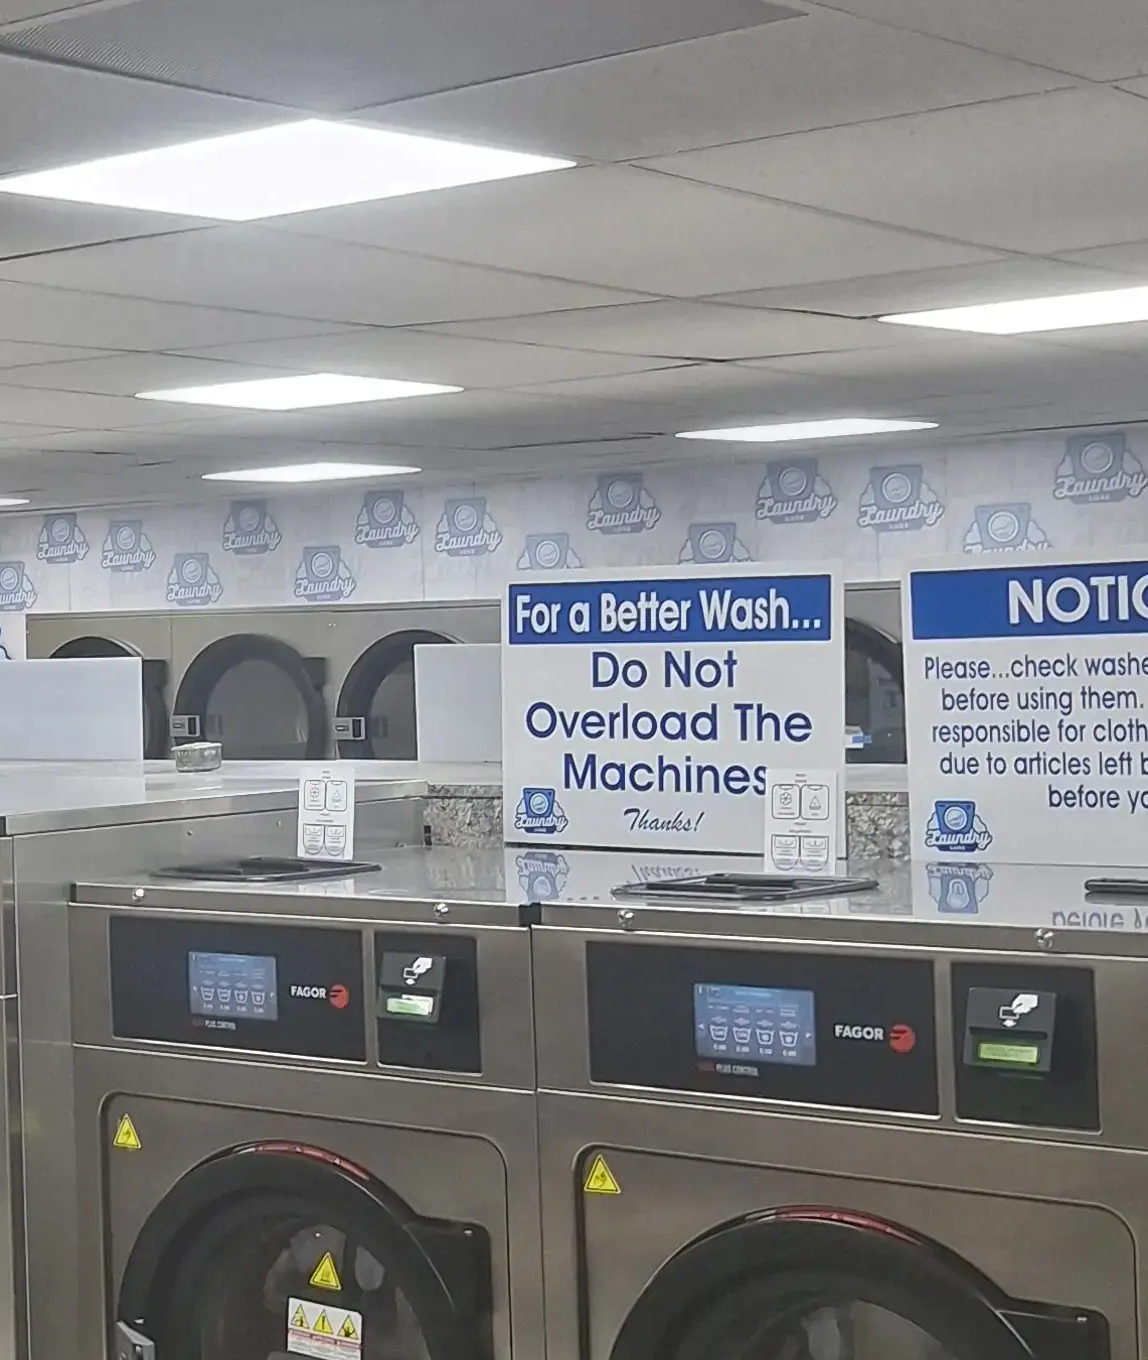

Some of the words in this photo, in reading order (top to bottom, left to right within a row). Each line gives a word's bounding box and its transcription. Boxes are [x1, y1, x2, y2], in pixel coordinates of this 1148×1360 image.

[1054, 470, 1148, 498] Laundry
[588, 506, 660, 530] Laundry
[757, 493, 837, 519] Laundry
[860, 500, 942, 525] Laundry
[224, 529, 281, 550] Laundry
[356, 522, 419, 543] Laundry
[436, 528, 502, 552] Laundry
[38, 540, 88, 559] Laundry
[102, 548, 154, 568] Laundry
[168, 582, 222, 602] Laundry
[295, 576, 354, 596] Laundry
[516, 594, 560, 634] For
[569, 602, 590, 632] a
[600, 591, 692, 632] Better
[699, 588, 822, 630] Wash...
[592, 651, 648, 688] Do
[664, 650, 738, 688] Not
[942, 688, 1010, 710] before
[1018, 686, 1072, 716] using
[1080, 686, 1144, 709] them.
[526, 702, 718, 740] Overload
[734, 703, 812, 742] The
[932, 719, 1050, 748] responsible
[1058, 718, 1086, 742] for
[1092, 718, 1148, 742] cloth
[564, 752, 766, 796] Machines
[940, 754, 979, 775] due
[986, 754, 1006, 774] to
[1014, 752, 1090, 775] articles
[1099, 752, 1132, 775] left
[1048, 784, 1120, 808] before
[515, 812, 568, 832] Laundry
[624, 808, 705, 832] Thanks!
[926, 830, 992, 850] Laundry
[291, 986, 326, 1000] FAGOR
[834, 1024, 884, 1040] FAGOR
